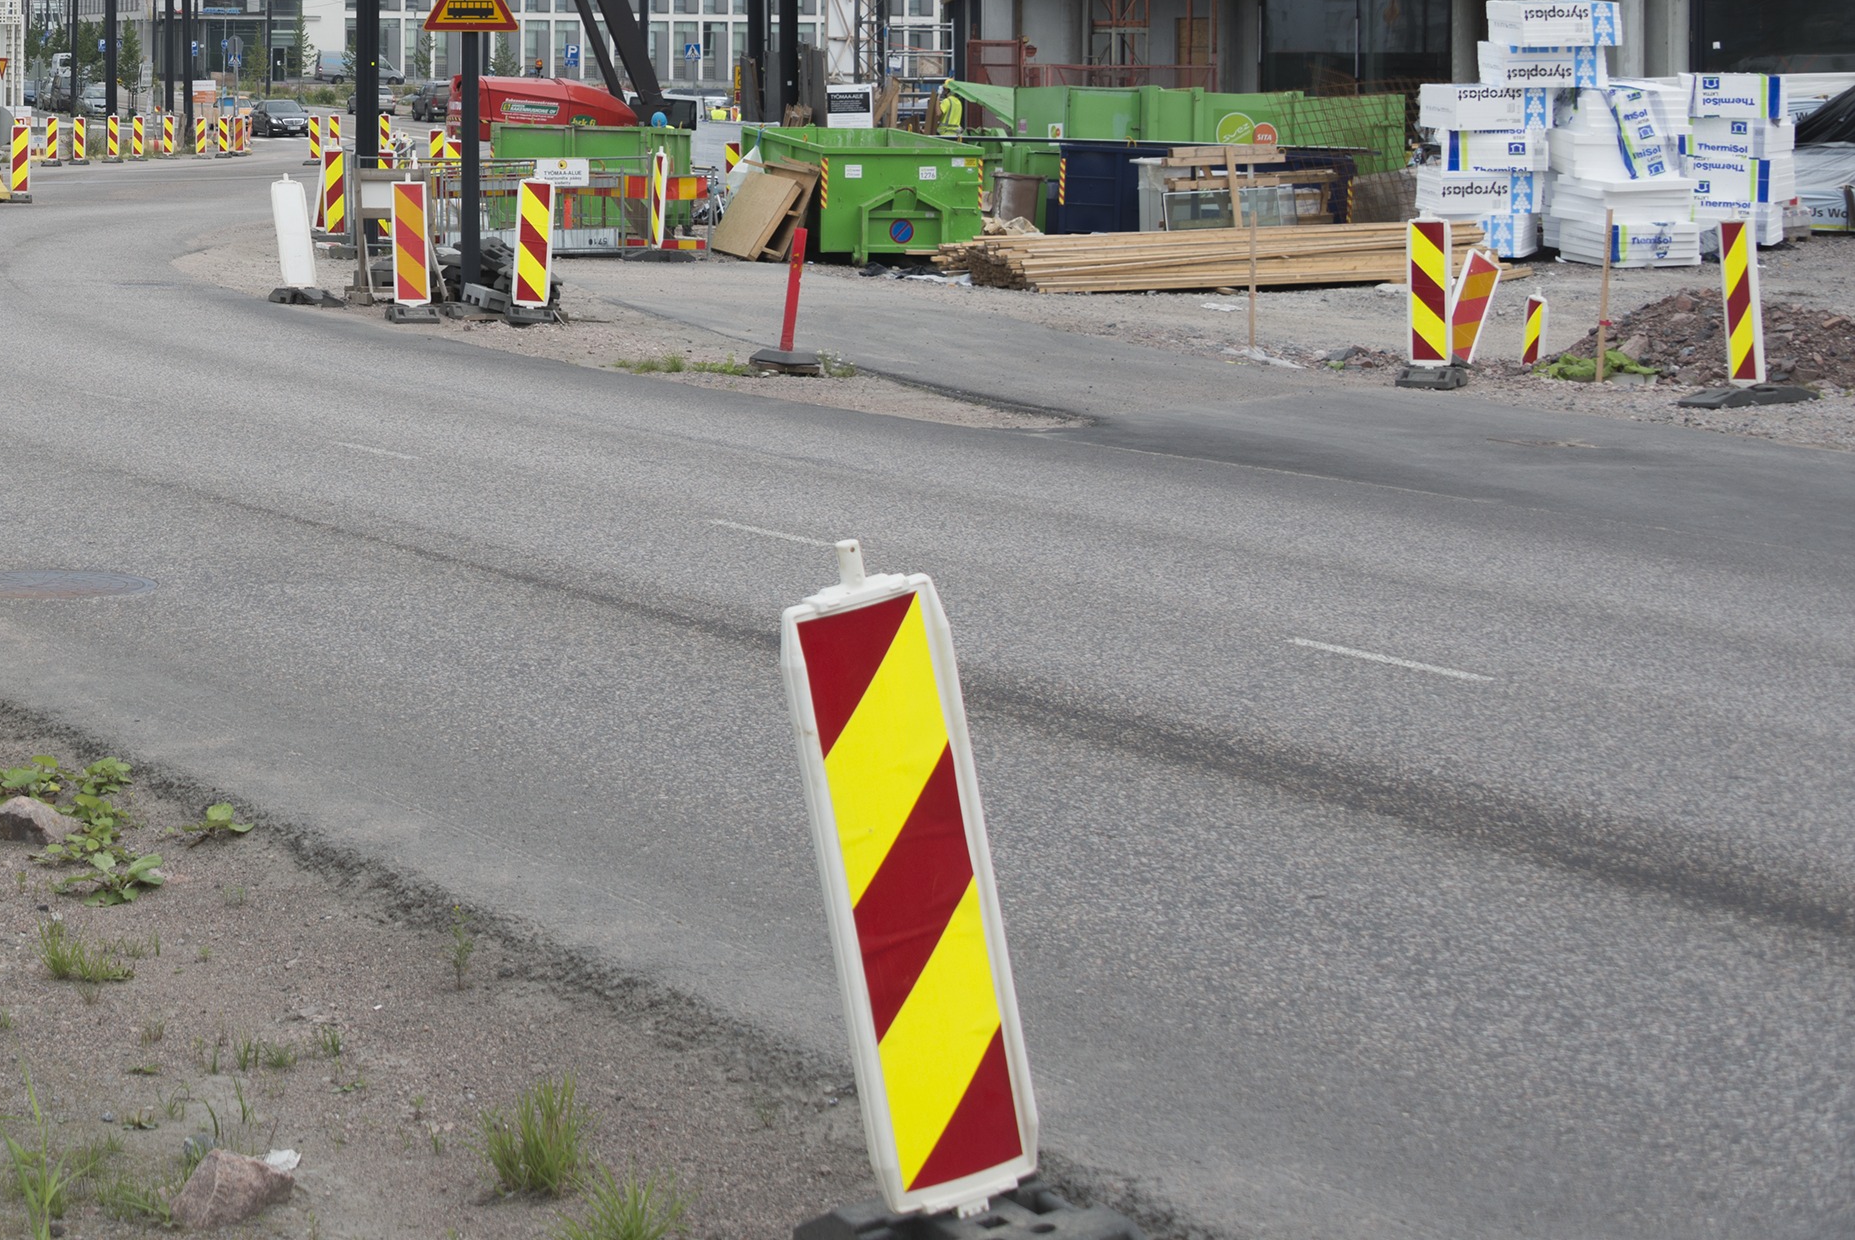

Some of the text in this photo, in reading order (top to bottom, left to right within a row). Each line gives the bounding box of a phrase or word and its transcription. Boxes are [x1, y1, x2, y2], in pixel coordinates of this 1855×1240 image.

[1524, 5, 1589, 21] styroplast
[1507, 64, 1572, 80] styroplast
[1458, 87, 1522, 101] styroplast
[1702, 97, 1755, 106] ThermiSol
[1697, 142, 1748, 153] ThermiSol
[1693, 162, 1745, 172] ThermiSol
[1442, 181, 1508, 197] styroplast
